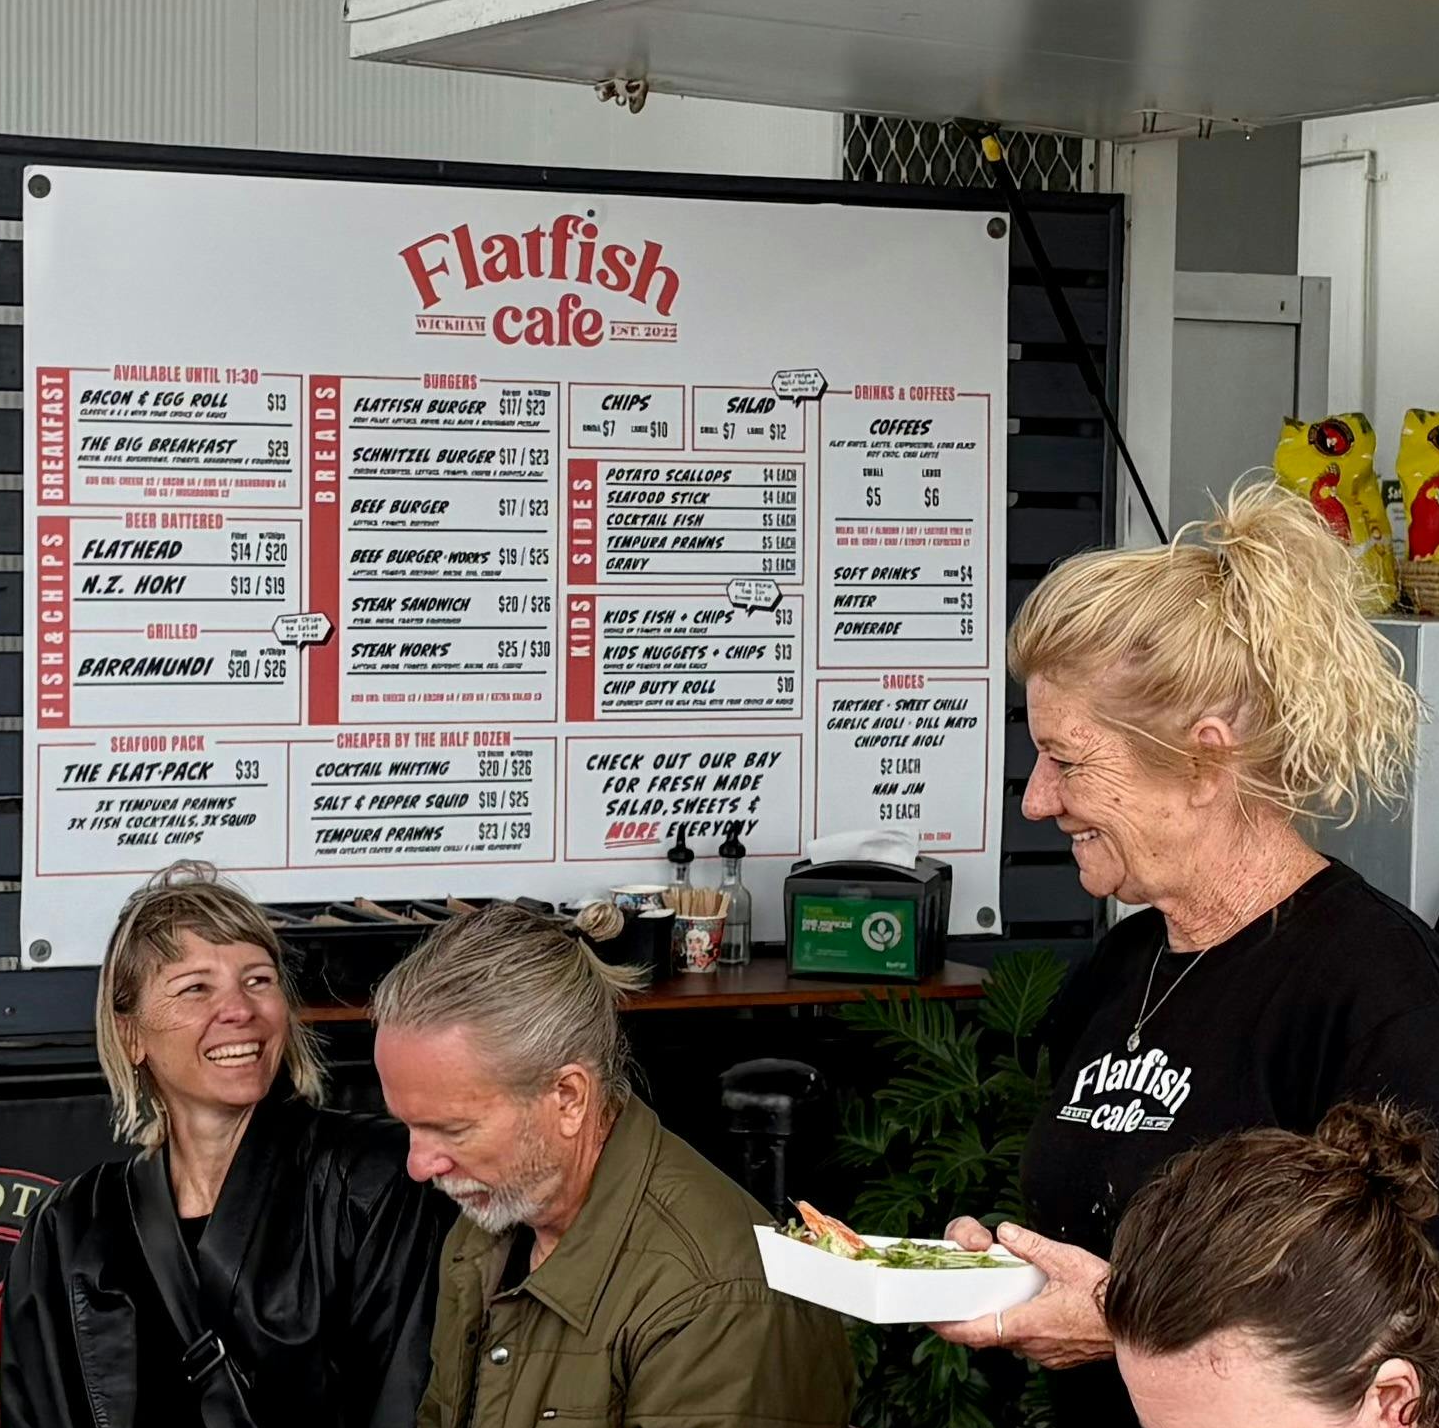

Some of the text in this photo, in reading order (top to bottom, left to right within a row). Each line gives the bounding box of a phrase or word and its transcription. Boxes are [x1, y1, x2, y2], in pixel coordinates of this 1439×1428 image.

[398, 214, 680, 317] Flatfish
[416, 318, 485, 331] WICKHAM
[493, 293, 604, 347] cafe
[114, 365, 258, 384] AVAILABLE UNTIL 11:30
[424, 374, 477, 390] BURGERS
[80, 390, 286, 411] BACON & EGG ROLL $13
[855, 385, 894, 400] DRINKS
[910, 386, 955, 401] COFFEES
[354, 398, 545, 416] FLATFISH BURGER $23
[602, 394, 651, 411] CHIPS
[727, 397, 775, 413] SALAD
[870, 419, 932, 435] COFFEES
[42, 375, 63, 499] BREAKFAST
[315, 388, 336, 502] BREADS
[81, 436, 288, 457] THE BIG BREAKFAST $29
[353, 447, 495, 463] SCHNITZEL BURGER
[606, 468, 732, 482] POTATO SCALLOPS
[607, 491, 710, 504] SEAFOOD STICK
[867, 487, 939, 507] $5 $6
[351, 499, 449, 514] BEEF BURGER
[126, 512, 223, 529] BEER BATTERED
[573, 480, 592, 564] SIDES
[607, 513, 704, 526] COCKTAIL FISH
[82, 540, 287, 561] FLATHEAD $14 $20
[607, 536, 724, 549] TEMPURA PRAWNS
[606, 558, 649, 570] GRAVY
[834, 567, 920, 580] SOFT DRINKS
[82, 575, 284, 595] N.Z. HOKI $13 $19
[352, 596, 550, 613] STEAK SANDWICH $20 $26
[834, 595, 877, 608] WATER
[604, 610, 734, 624] KIDS FISH CHIPS
[42, 535, 63, 717] FISH & CHIPS
[147, 624, 197, 639] GRILLED
[571, 601, 590, 656] KIDS
[835, 622, 902, 635] POWERADE
[351, 640, 550, 658] STEAK WORKS $25 $30
[603, 645, 766, 660] KIDS NUGGETS CHIPS
[78, 657, 286, 678] BARRAMUNDI $20 $26
[604, 676, 794, 694] CHIP BUTY ROLL $10
[883, 675, 924, 689] SAUCES
[832, 699, 968, 711] TARTARE SWEET CHILLI
[827, 717, 977, 730] GARLIC AIOLI DILL MAYO
[111, 735, 204, 752] SEAFOOD PACK
[337, 731, 510, 748] CHEAPER BY THE HALF DOZEN
[855, 735, 945, 748] CHIPOTLE AIOLI
[316, 759, 531, 777] COCKTAIL WHITING $20 $26
[587, 752, 781, 770] CHECK OUT OUR BAY
[64, 759, 259, 783] THE $33
[603, 774, 763, 793] FOR FRESH MADE
[902, 783, 925, 795] JIM
[119, 797, 236, 812] TEMPURA PRAWNS
[314, 796, 351, 810] SALT
[368, 795, 421, 809] PEPPER
[426, 794, 469, 809] SQUID
[479, 791, 497, 808] $19
[510, 791, 528, 808] $25
[90, 814, 256, 830] FISH SQUID
[117, 831, 204, 846] SMALL CHIPS
[315, 822, 530, 843] TEMPURA PRAWNS $23 $29
[605, 821, 661, 842] MORE
[1069, 1048, 1192, 1115] Flatfish
[1091, 1099, 1145, 1132] cafe
